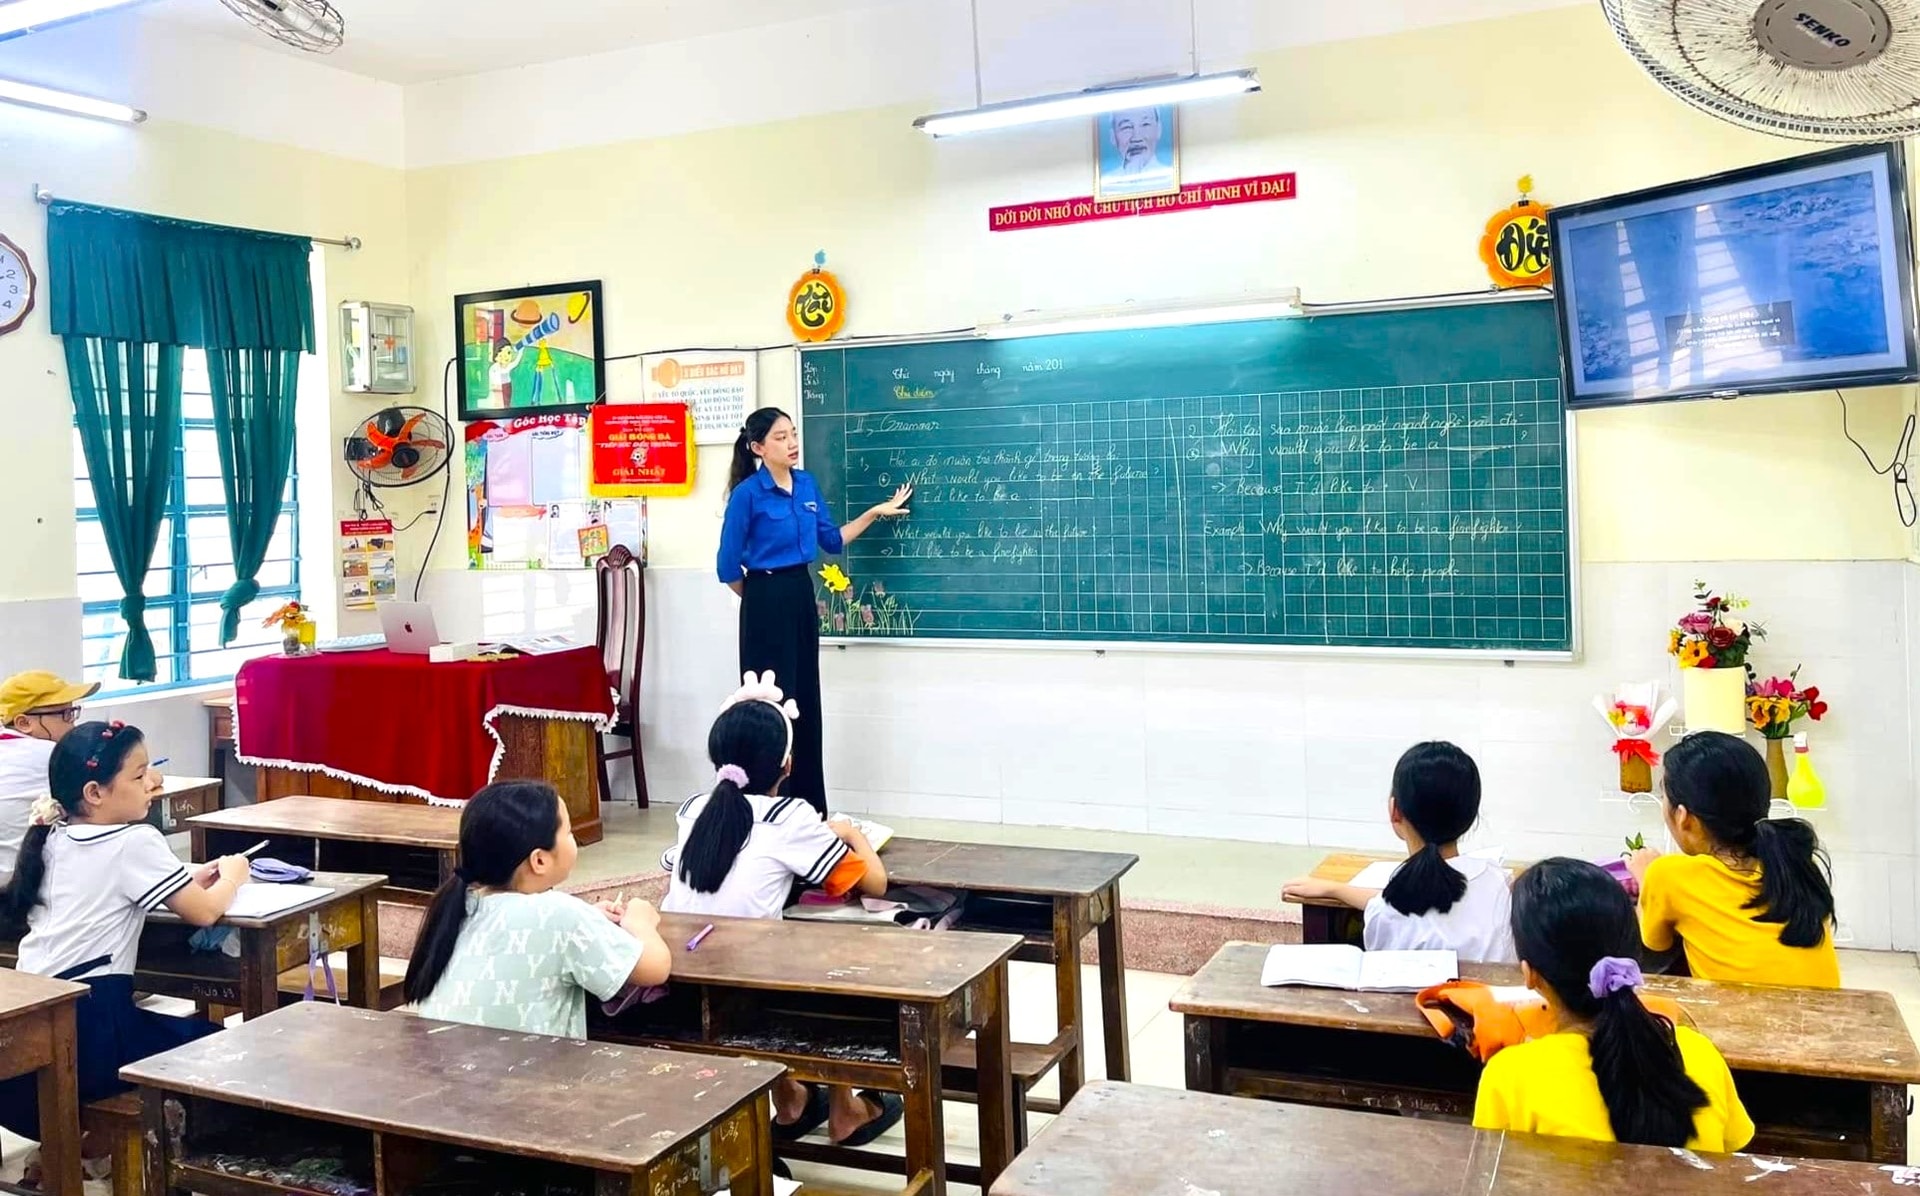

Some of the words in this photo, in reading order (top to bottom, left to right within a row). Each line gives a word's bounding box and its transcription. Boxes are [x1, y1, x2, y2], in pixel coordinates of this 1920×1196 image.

[1793, 12, 1851, 47] SENKO
[995, 208, 1017, 226] ĐỜI
[1020, 205, 1042, 222] ĐỜI
[1044, 202, 1072, 220] NHỚ
[1074, 202, 1093, 217] ƠN
[1178, 186, 1203, 205] CHÍ
[1205, 186, 1242, 202] MINH
[6, 269, 16, 279] 2
[9, 284, 18, 295] 3
[3, 299, 12, 309] 4
[513, 416, 536, 429] Góc
[538, 414, 561, 425] Học
[1268, 439, 1309, 455] would
[1313, 446, 1342, 465] you
[905, 467, 937, 485] What
[945, 467, 980, 484] would
[892, 523, 921, 540] What
[1390, 555, 1415, 582] help
[1422, 558, 1461, 583] people
